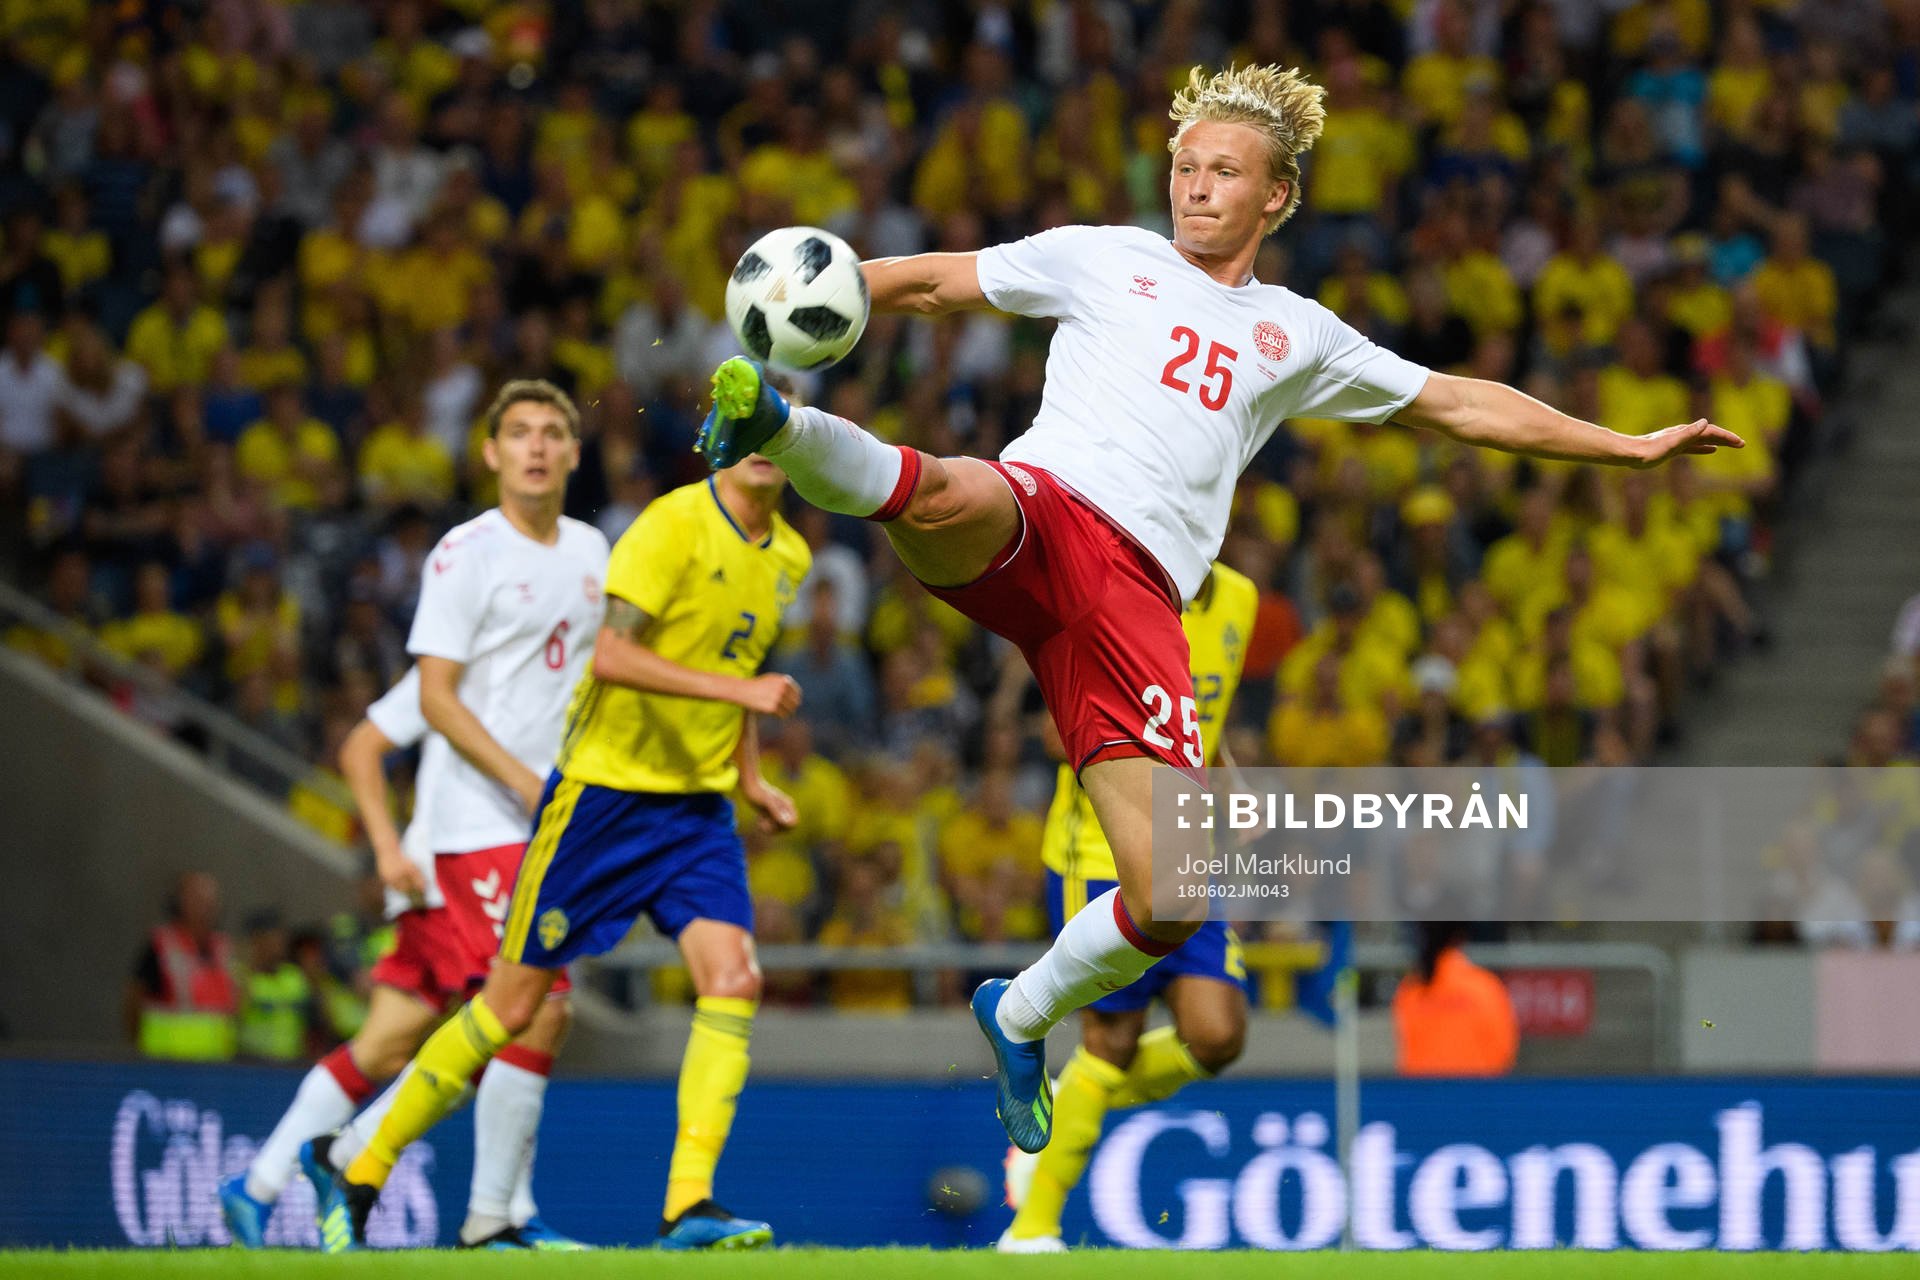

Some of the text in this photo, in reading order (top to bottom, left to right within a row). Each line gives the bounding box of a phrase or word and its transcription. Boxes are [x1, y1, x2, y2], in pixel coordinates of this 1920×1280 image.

[1160, 325, 1239, 412] 25
[545, 619, 570, 671] 6
[719, 611, 756, 660] 2
[1141, 684, 1204, 768] 25
[1089, 1099, 1920, 1251] Götenehu
